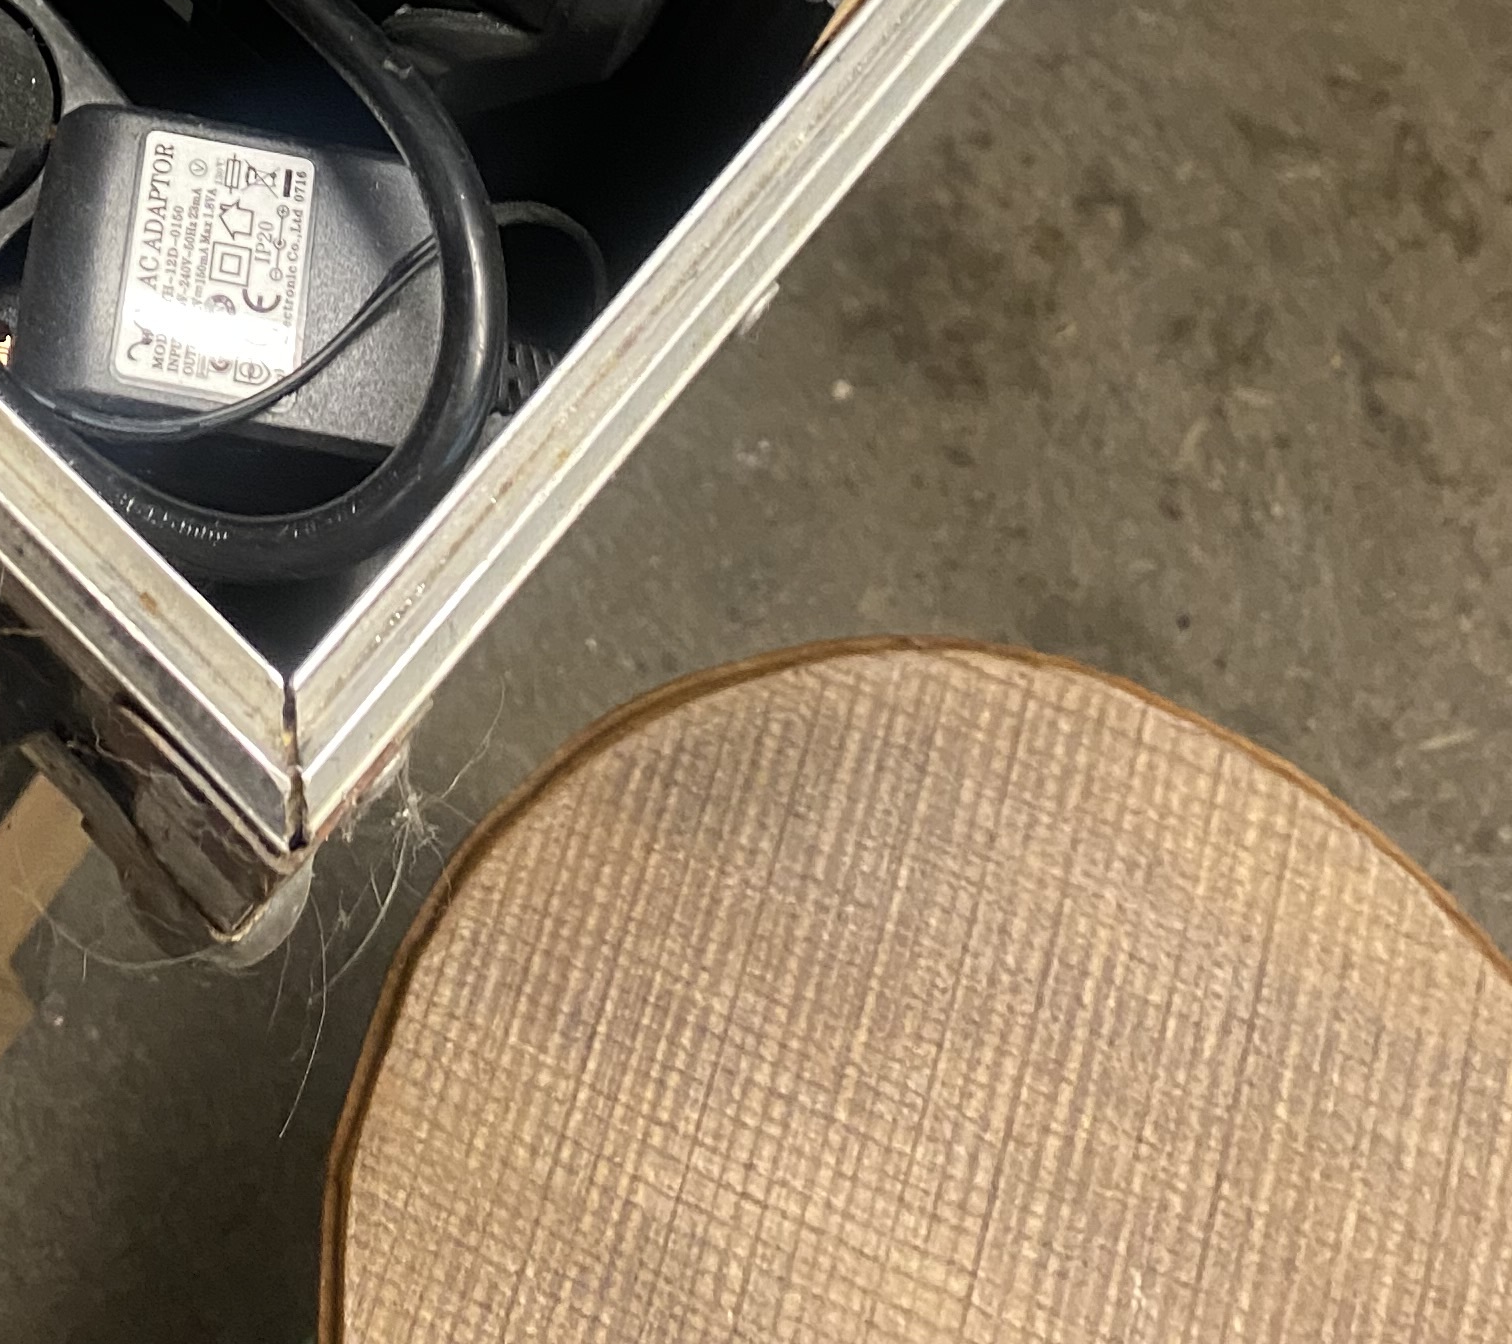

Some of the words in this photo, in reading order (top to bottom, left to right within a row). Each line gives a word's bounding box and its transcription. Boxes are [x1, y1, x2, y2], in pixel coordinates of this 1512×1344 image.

[144, 143, 175, 253] ADAPTOR
[294, 171, 307, 202] 0716
[254, 221, 273, 264] IP20
[137, 255, 160, 291] AC
